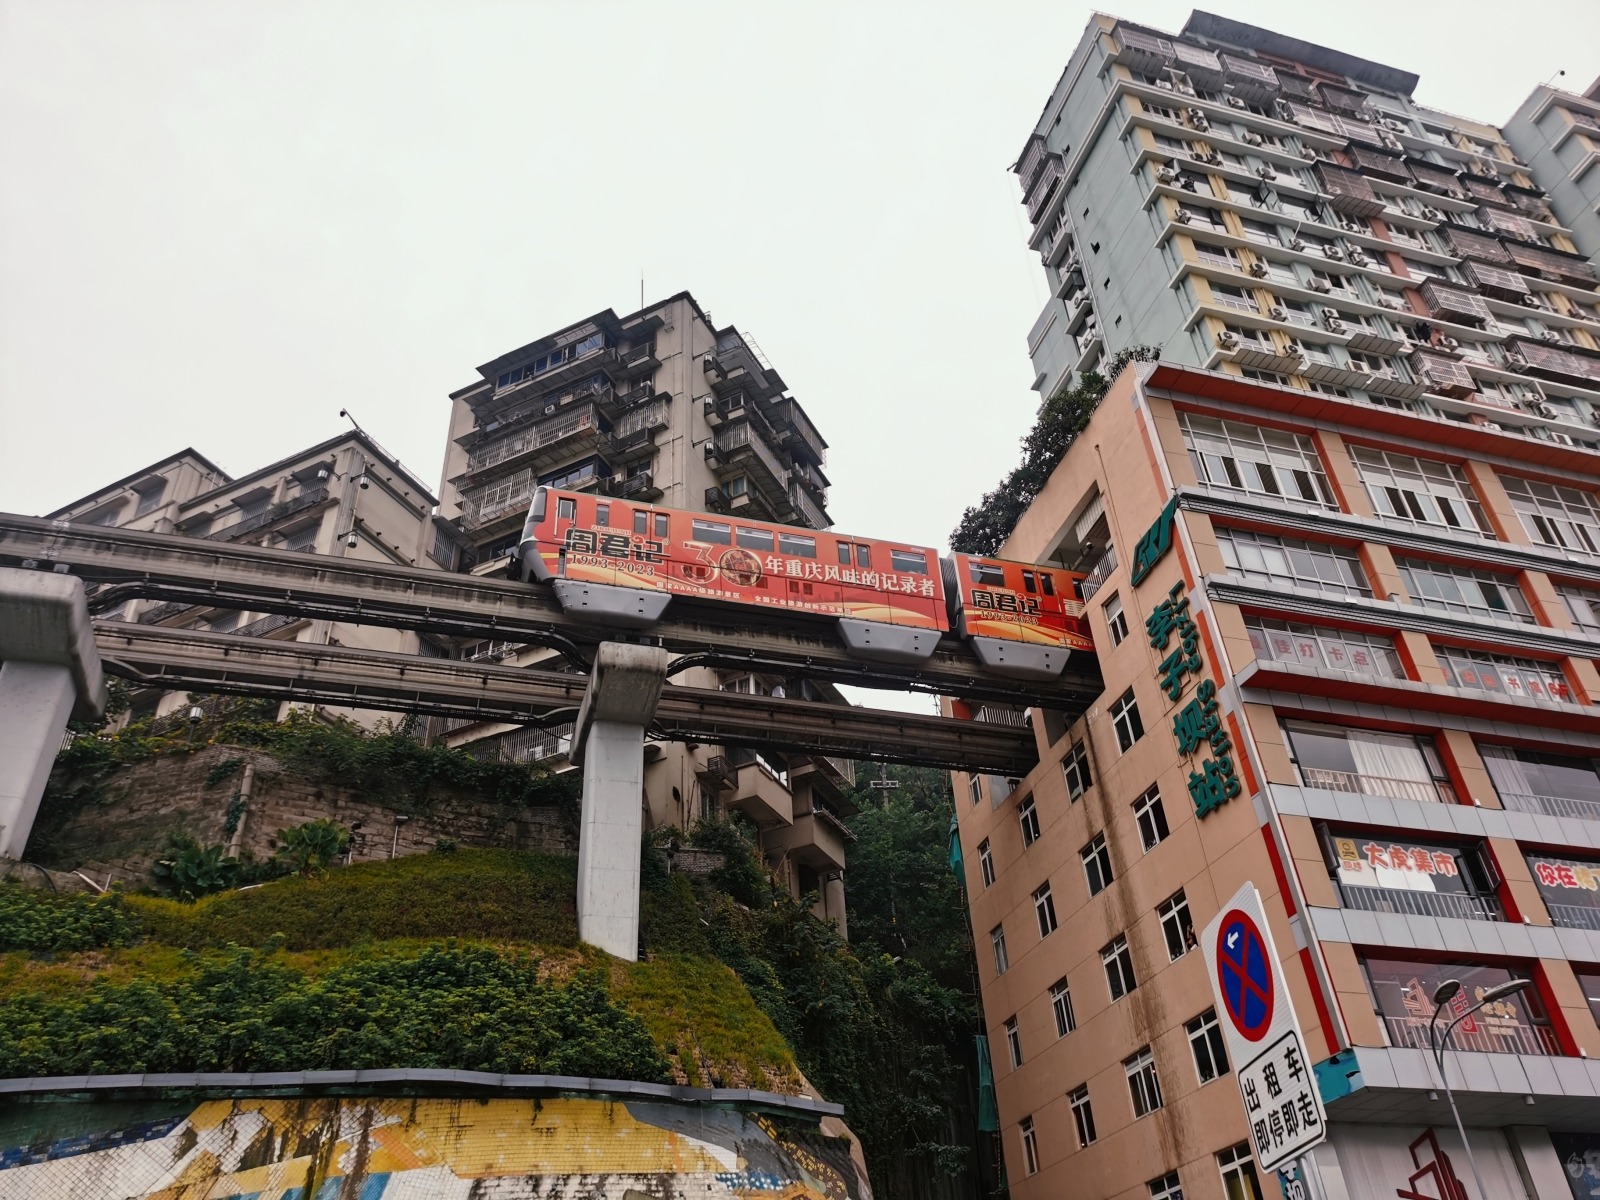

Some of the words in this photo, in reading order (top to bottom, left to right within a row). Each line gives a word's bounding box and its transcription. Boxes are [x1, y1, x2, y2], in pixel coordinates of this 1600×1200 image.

[565, 528, 664, 564] 周君记
[571, 554, 654, 577] 1993-2023
[765, 555, 935, 597] 年重庆风味的记录者
[972, 588, 1041, 616] 周君记
[1146, 598, 1228, 820] 李子坝站
[1197, 678, 1241, 798] Station
[1363, 842, 1458, 877] 大虎集市
[1244, 1047, 1303, 1113] 出租车
[1254, 1091, 1318, 1154] 即停即走
